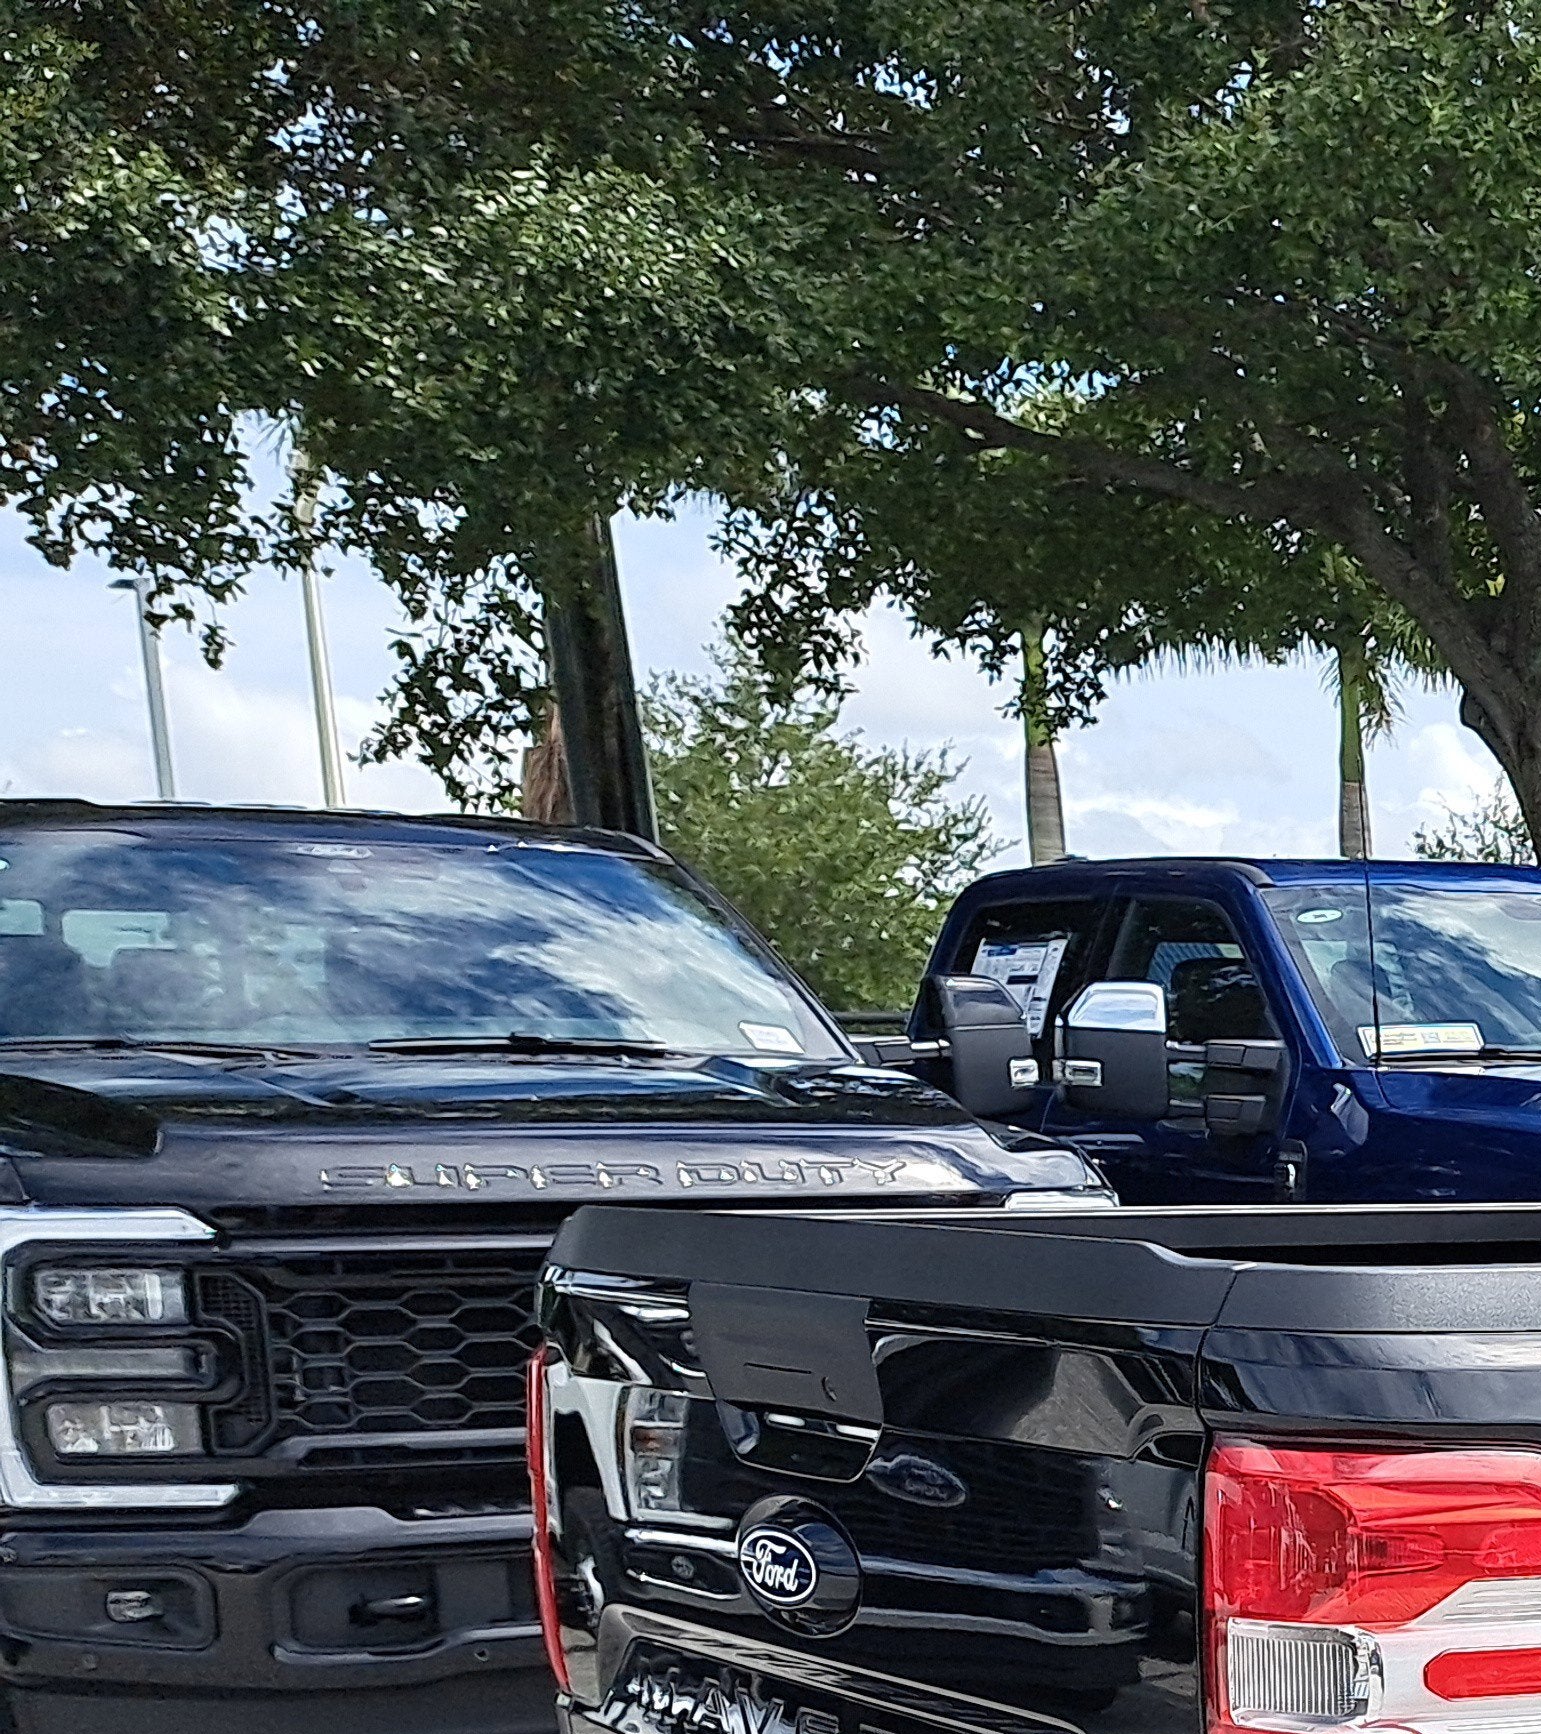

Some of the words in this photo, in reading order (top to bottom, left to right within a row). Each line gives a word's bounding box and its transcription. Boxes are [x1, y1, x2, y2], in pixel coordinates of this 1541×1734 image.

[320, 1161, 663, 1192] SUPER
[675, 1156, 907, 1190] DUTY
[741, 1538, 800, 1592] Ford
